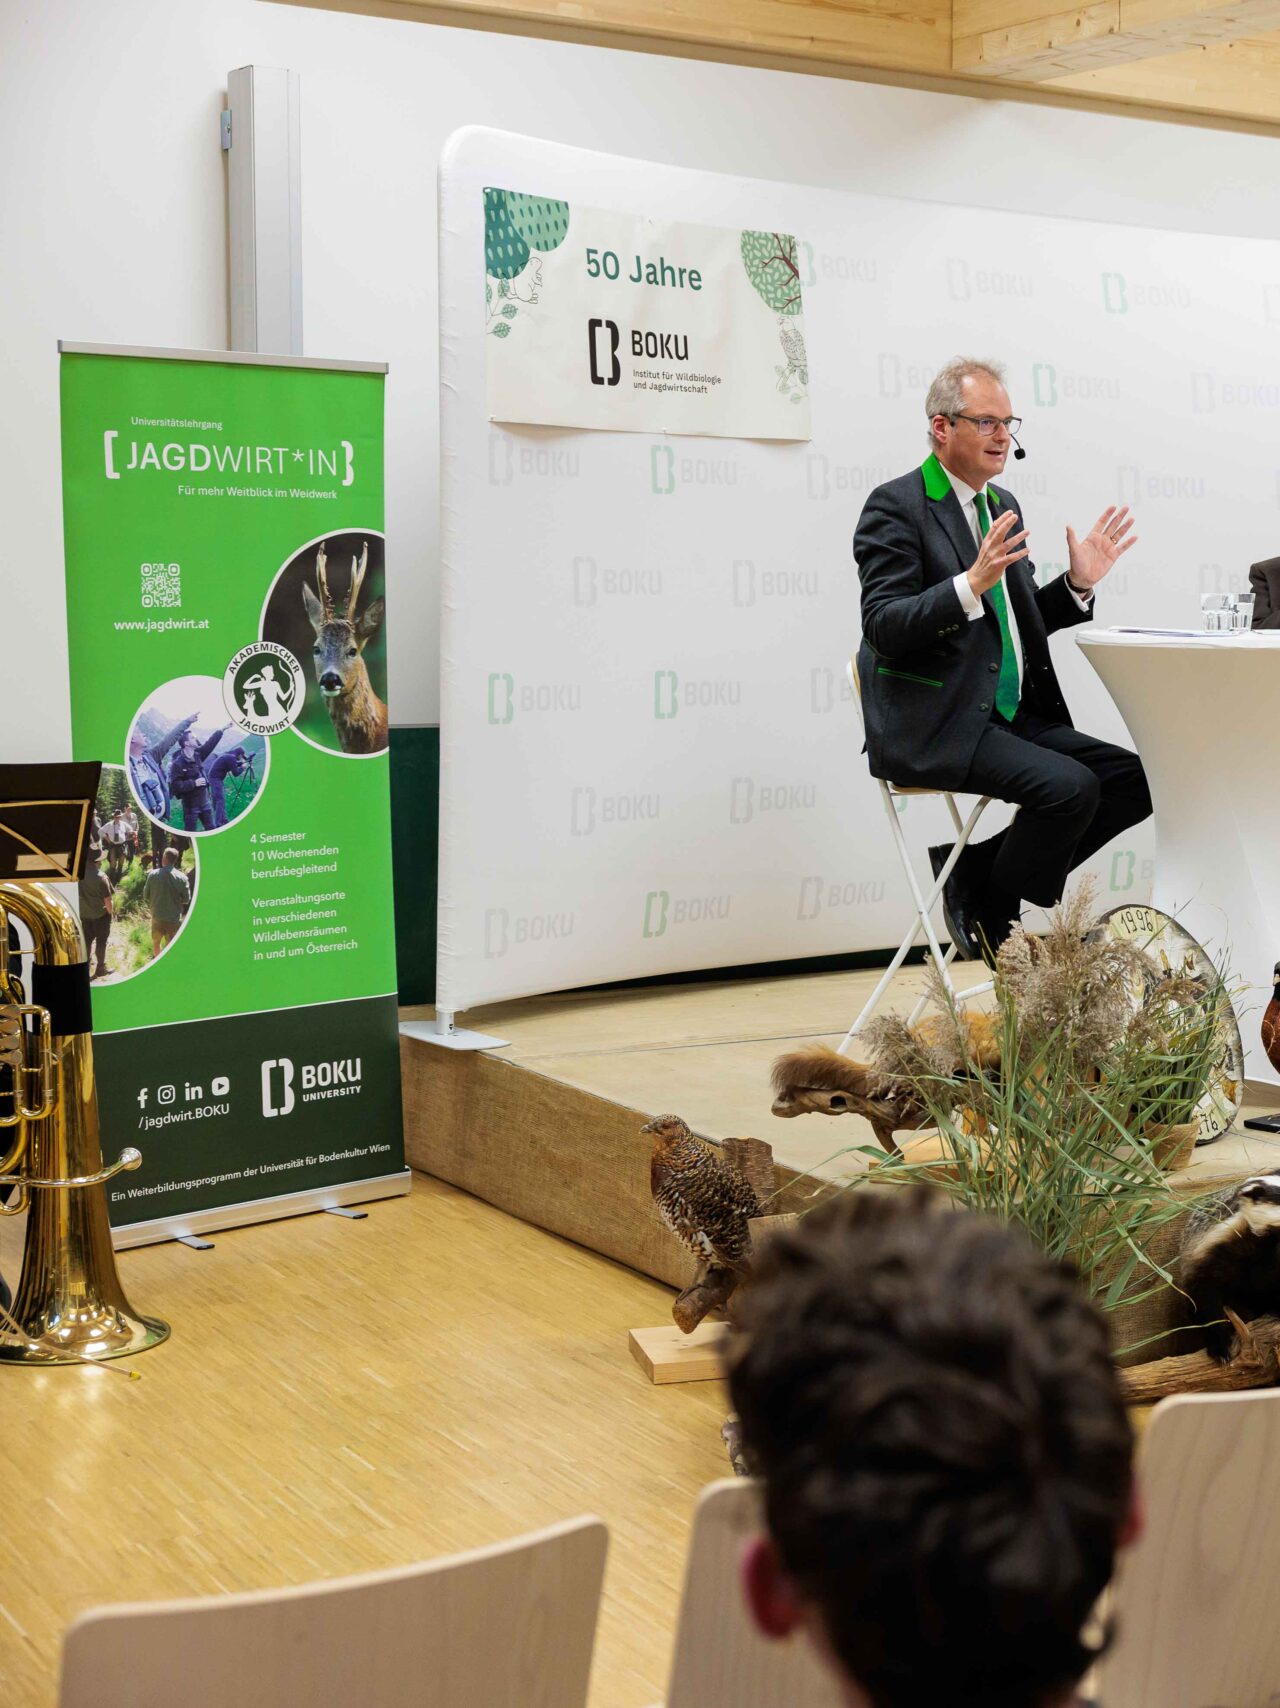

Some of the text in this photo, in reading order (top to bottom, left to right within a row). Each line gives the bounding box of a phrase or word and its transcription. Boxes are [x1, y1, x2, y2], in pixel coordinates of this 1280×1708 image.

[586, 248, 702, 291] 50 Jahre
[631, 329, 689, 361] BOKU
[633, 369, 722, 386] Institut für Wildbiologie
[633, 381, 708, 394] und Jagdwirtschaft
[131, 416, 223, 431] Universitätslehrgang
[178, 485, 337, 500] Für mehr Weitblick im Weidwerk
[114, 618, 210, 633] www.jagdwirt.at
[229, 642, 300, 675] AKADEMISCHER
[519, 683, 582, 712] BOKU
[684, 679, 742, 707] BOKU
[239, 716, 291, 734] JAGDWIRT
[601, 793, 661, 822] BOKU
[759, 783, 817, 812] BOKU
[250, 831, 306, 844] 4 Semester
[251, 845, 339, 862] 10 Wochenenden
[251, 861, 338, 879] berufsbegleitend
[252, 890, 346, 908] Veranstaltungsorte
[827, 879, 886, 907] BOKU
[253, 908, 337, 926] in verschiedenen
[673, 894, 732, 924] BOKU
[253, 924, 348, 943] Wildlebensräumen
[514, 911, 575, 943] BOKU
[254, 939, 358, 960] in und um Österreich
[301, 1057, 362, 1090] BOKU
[302, 1085, 362, 1102] UNIVERSITY
[111, 1143, 391, 1202] Ein Weiterbildungsprogramm der Universität für Bodenkultur Wien
